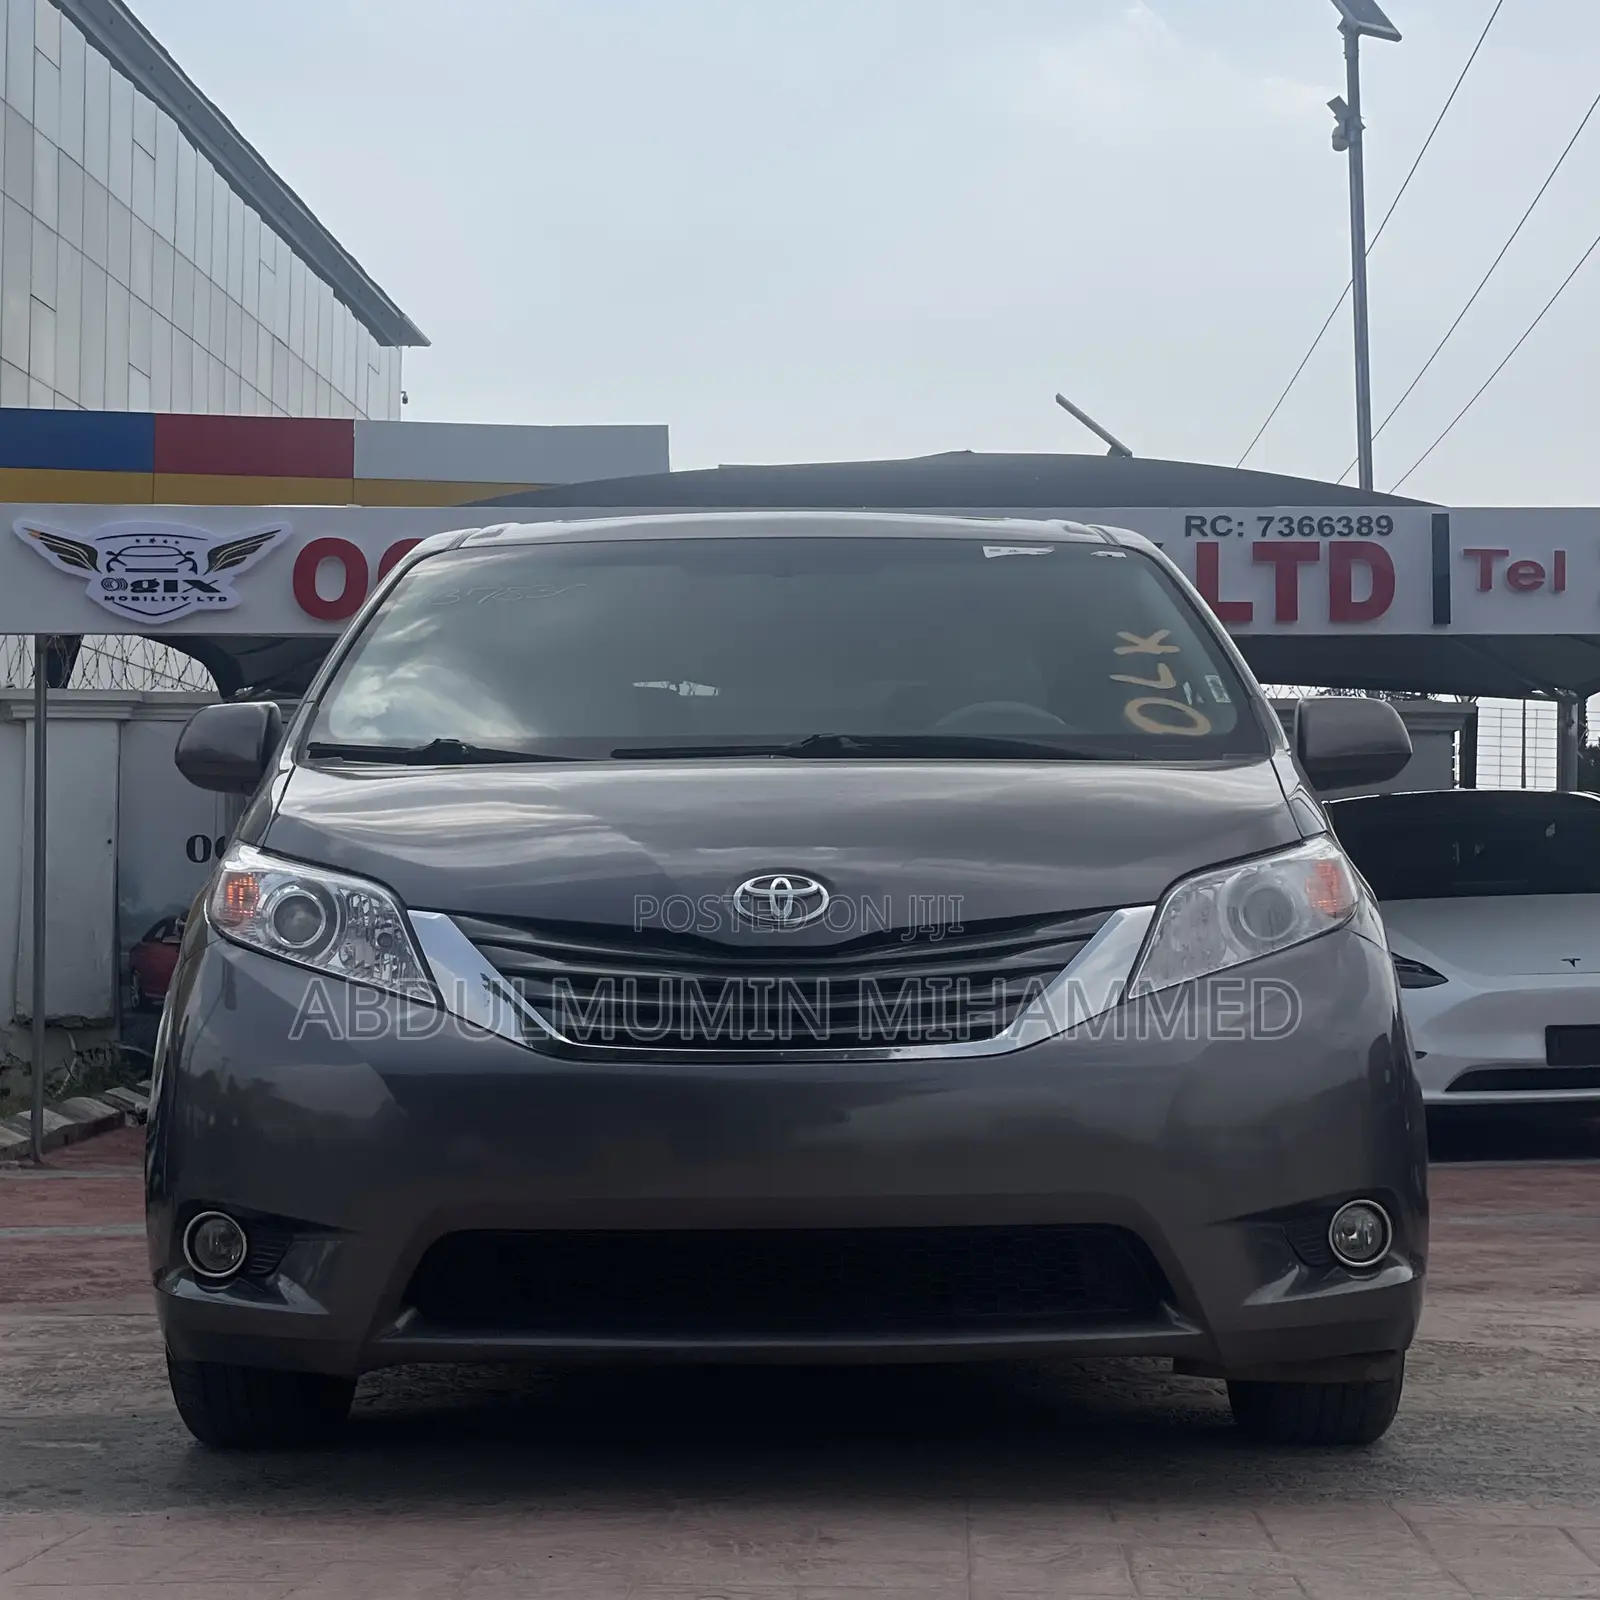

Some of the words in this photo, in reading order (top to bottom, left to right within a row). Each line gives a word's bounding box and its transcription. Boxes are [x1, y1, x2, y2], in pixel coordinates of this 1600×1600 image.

[1184, 514, 1245, 538] RC:
[1256, 514, 1394, 538] 7366389
[1195, 540, 1396, 623] LTD
[1463, 548, 1567, 592] Tel
[103, 594, 190, 602] MOBILITY
